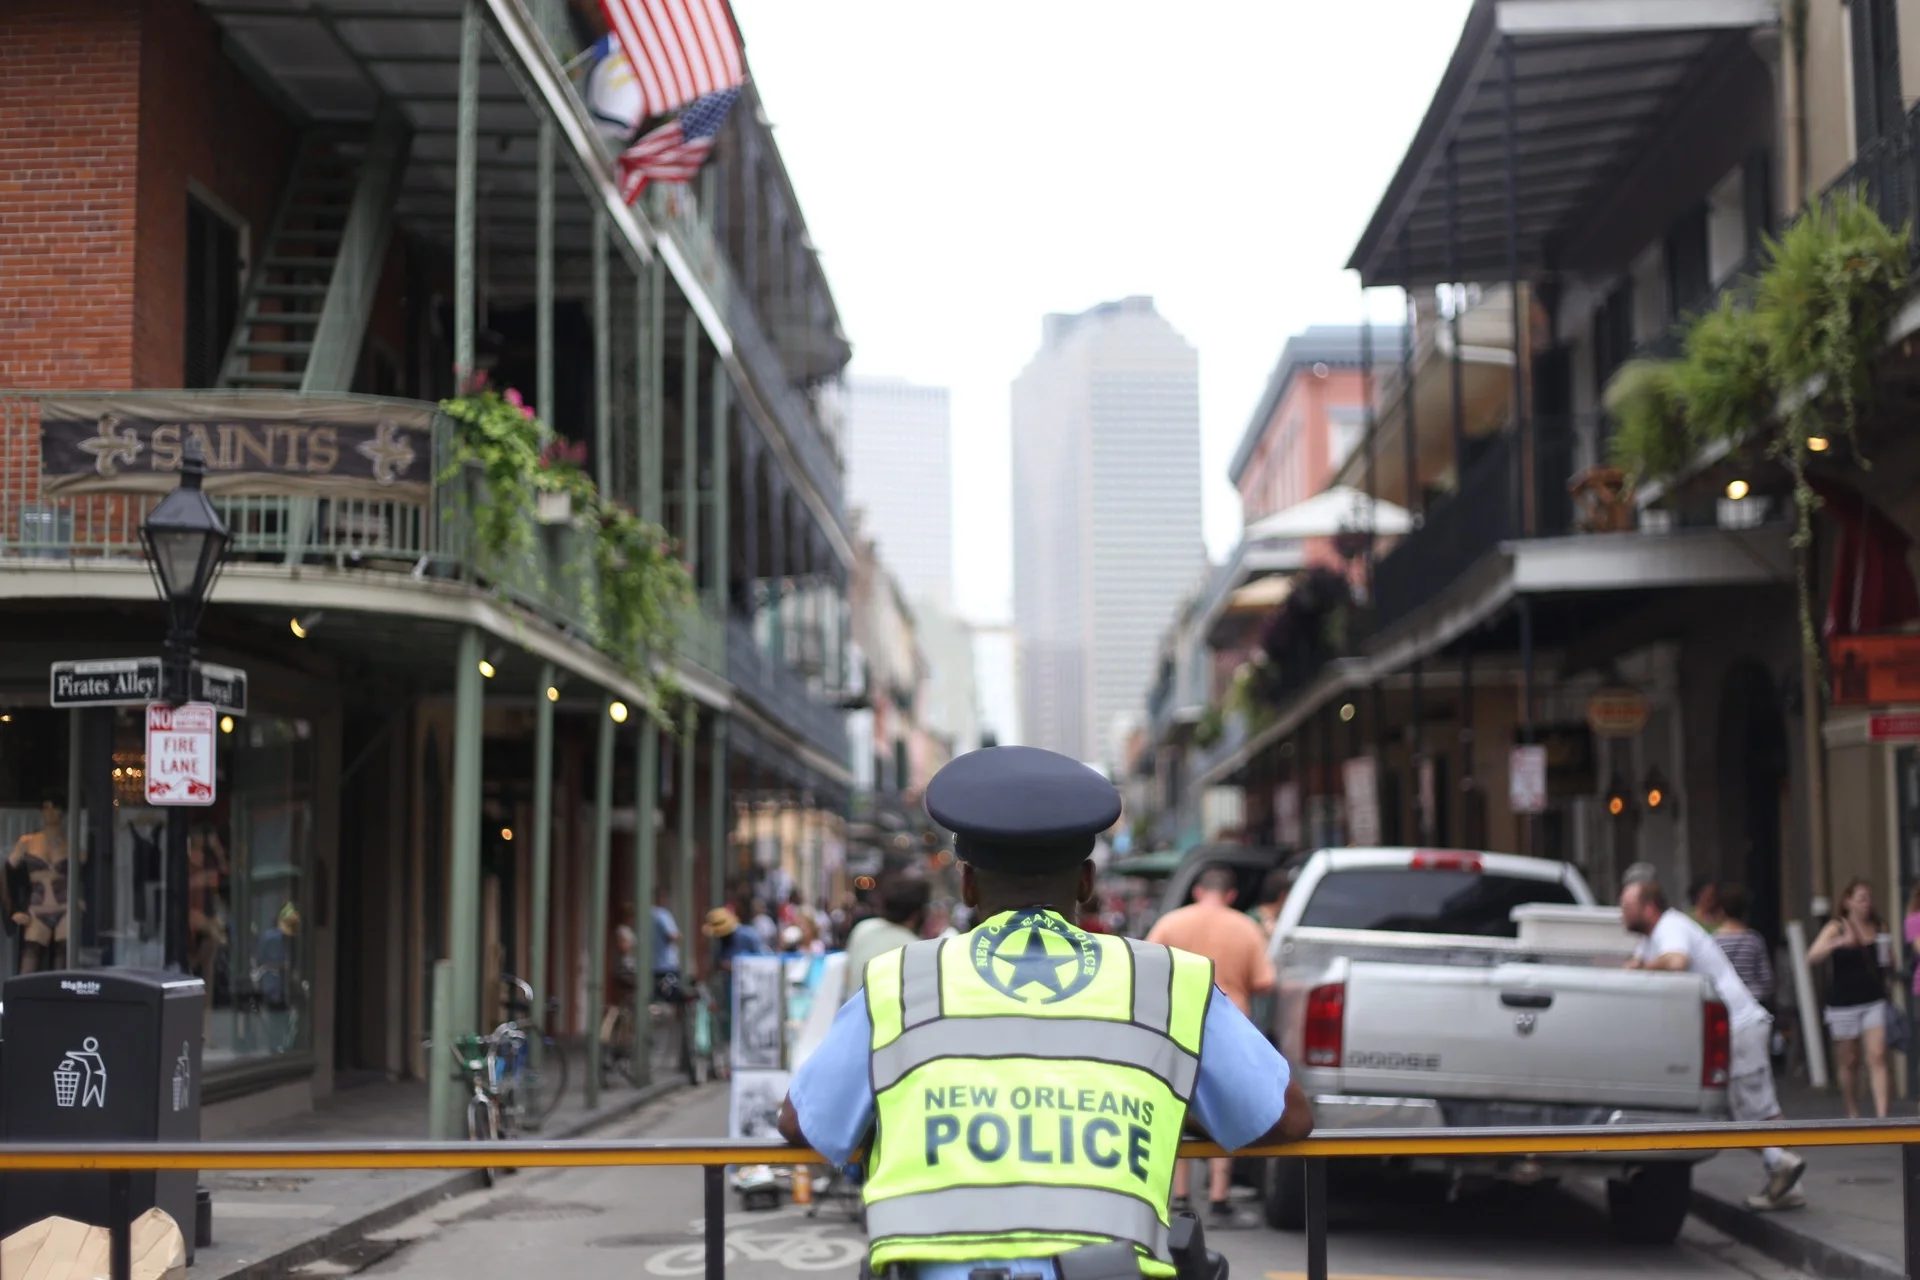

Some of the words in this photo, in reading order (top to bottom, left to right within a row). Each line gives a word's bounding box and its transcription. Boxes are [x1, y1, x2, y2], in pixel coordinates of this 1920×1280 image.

[152, 423, 339, 473] SAINTS
[57, 674, 110, 696] Pirates
[114, 672, 156, 700] Alley
[151, 709, 173, 728] NO
[163, 736, 197, 754] FIRE
[160, 758, 200, 775] LANE
[975, 936, 991, 967] NEW
[1073, 931, 1097, 976] OLICE
[1347, 1050, 1441, 1071] DODGE
[925, 1086, 998, 1110] NEW
[1010, 1086, 1154, 1126] ORLEANS
[925, 1112, 1152, 1184] POLICE
